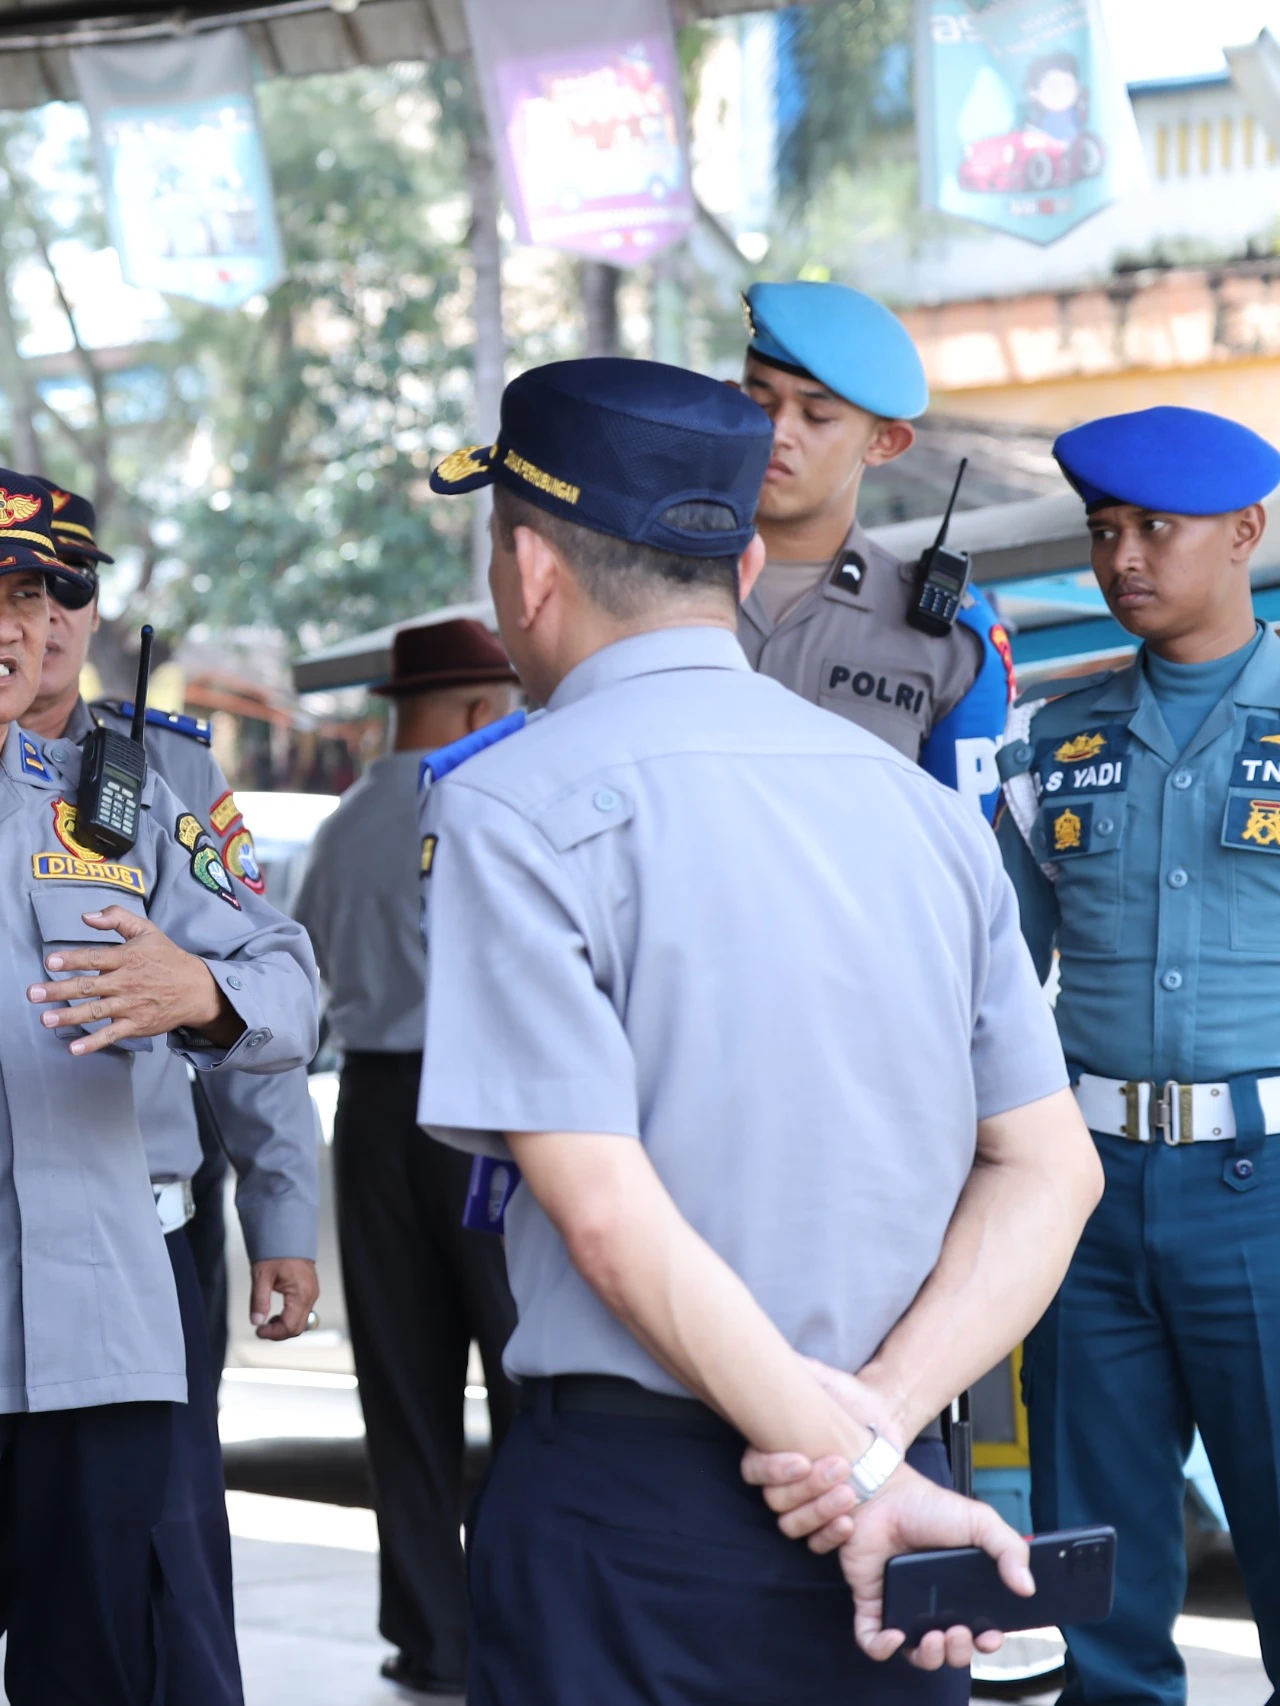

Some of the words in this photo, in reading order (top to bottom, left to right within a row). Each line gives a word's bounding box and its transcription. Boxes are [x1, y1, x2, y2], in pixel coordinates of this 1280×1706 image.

[829, 665, 924, 714] POLRI
[1073, 761, 1122, 788] YADI
[48, 857, 134, 884] DISHUB
